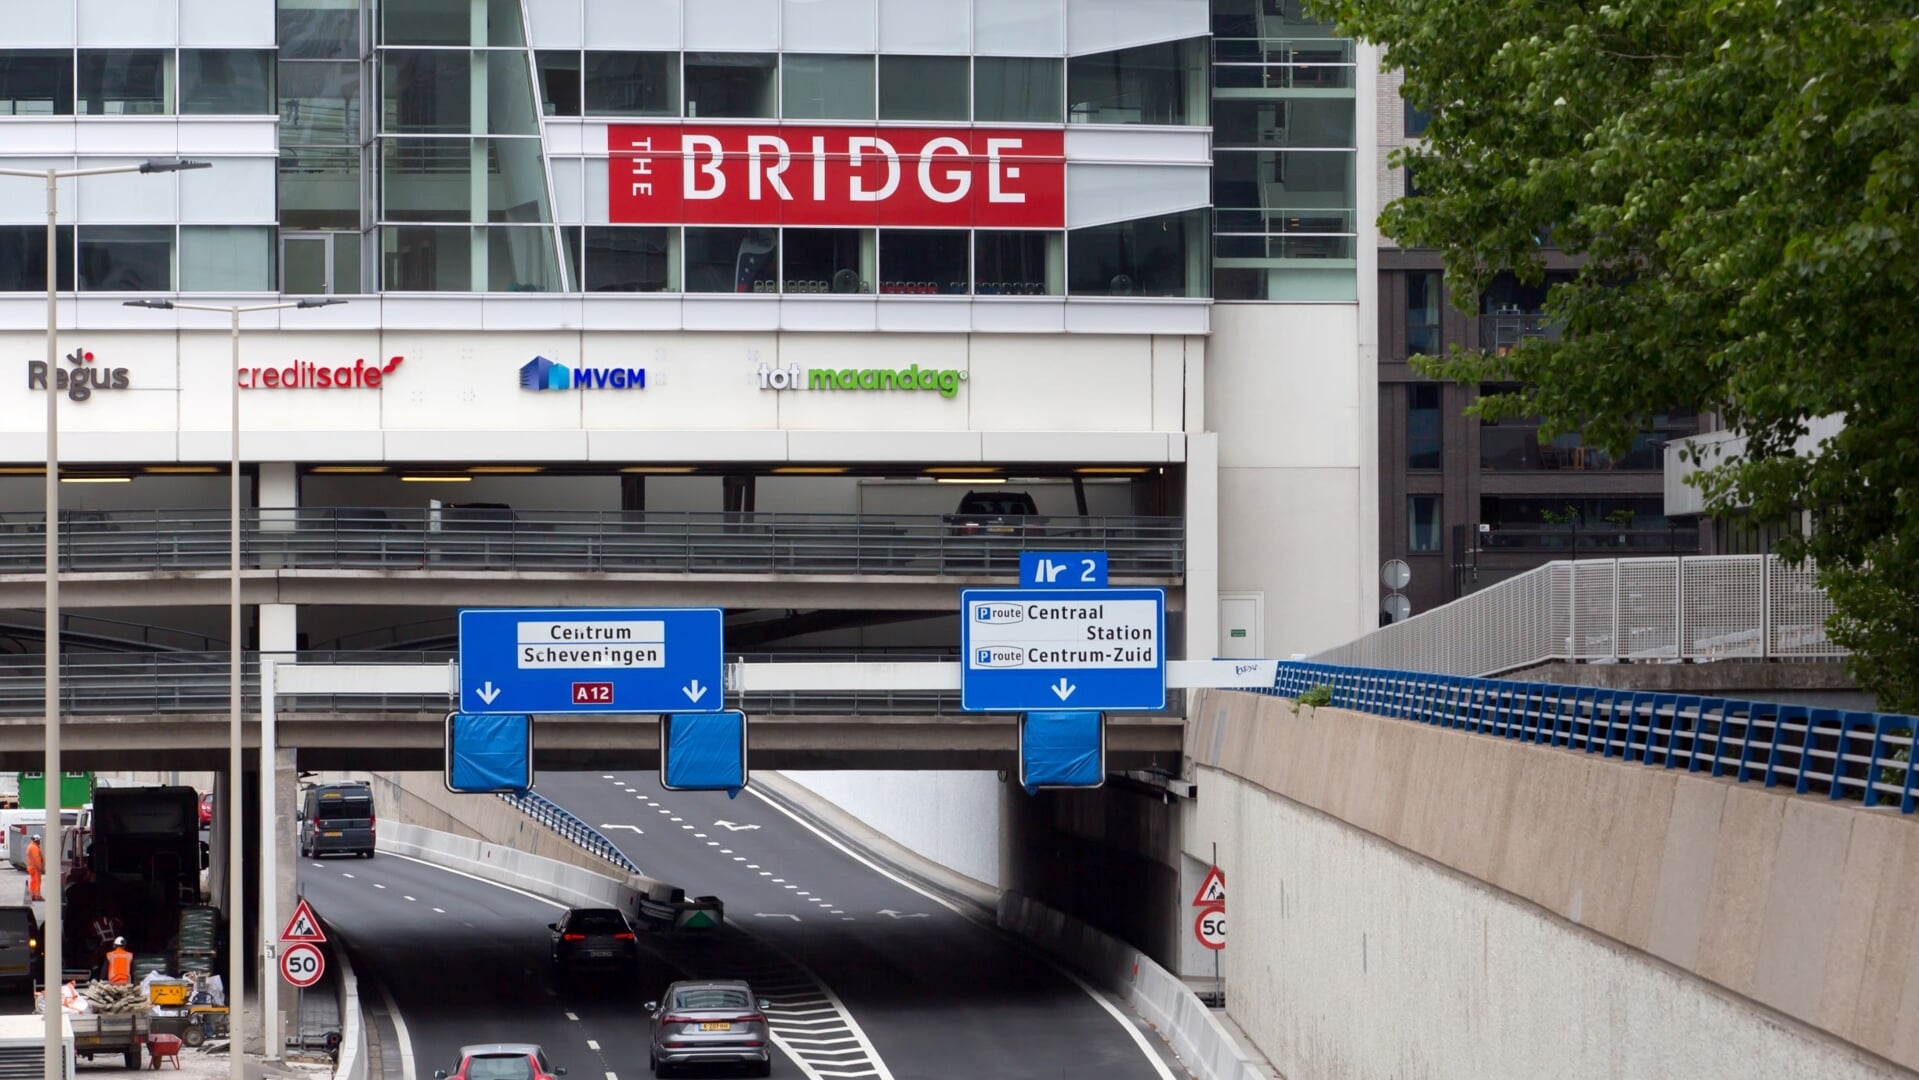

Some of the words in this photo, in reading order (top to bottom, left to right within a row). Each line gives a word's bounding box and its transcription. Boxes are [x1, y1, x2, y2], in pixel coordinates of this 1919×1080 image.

[632, 137, 653, 197] THE
[682, 134, 1026, 203] BRIDGE
[28, 359, 130, 402] Regus
[237, 358, 382, 389] creditsafe
[573, 368, 646, 390] MVGM
[758, 363, 800, 390] tot
[1080, 559, 1096, 582] 2
[993, 608, 1021, 618] route
[1028, 604, 1104, 620] Centraal
[1087, 625, 1152, 641] Station
[993, 651, 1021, 661] route
[1028, 647, 1152, 663] Centrum-Zuid
[1203, 920, 1225, 936] 50
[289, 956, 316, 973] 50
